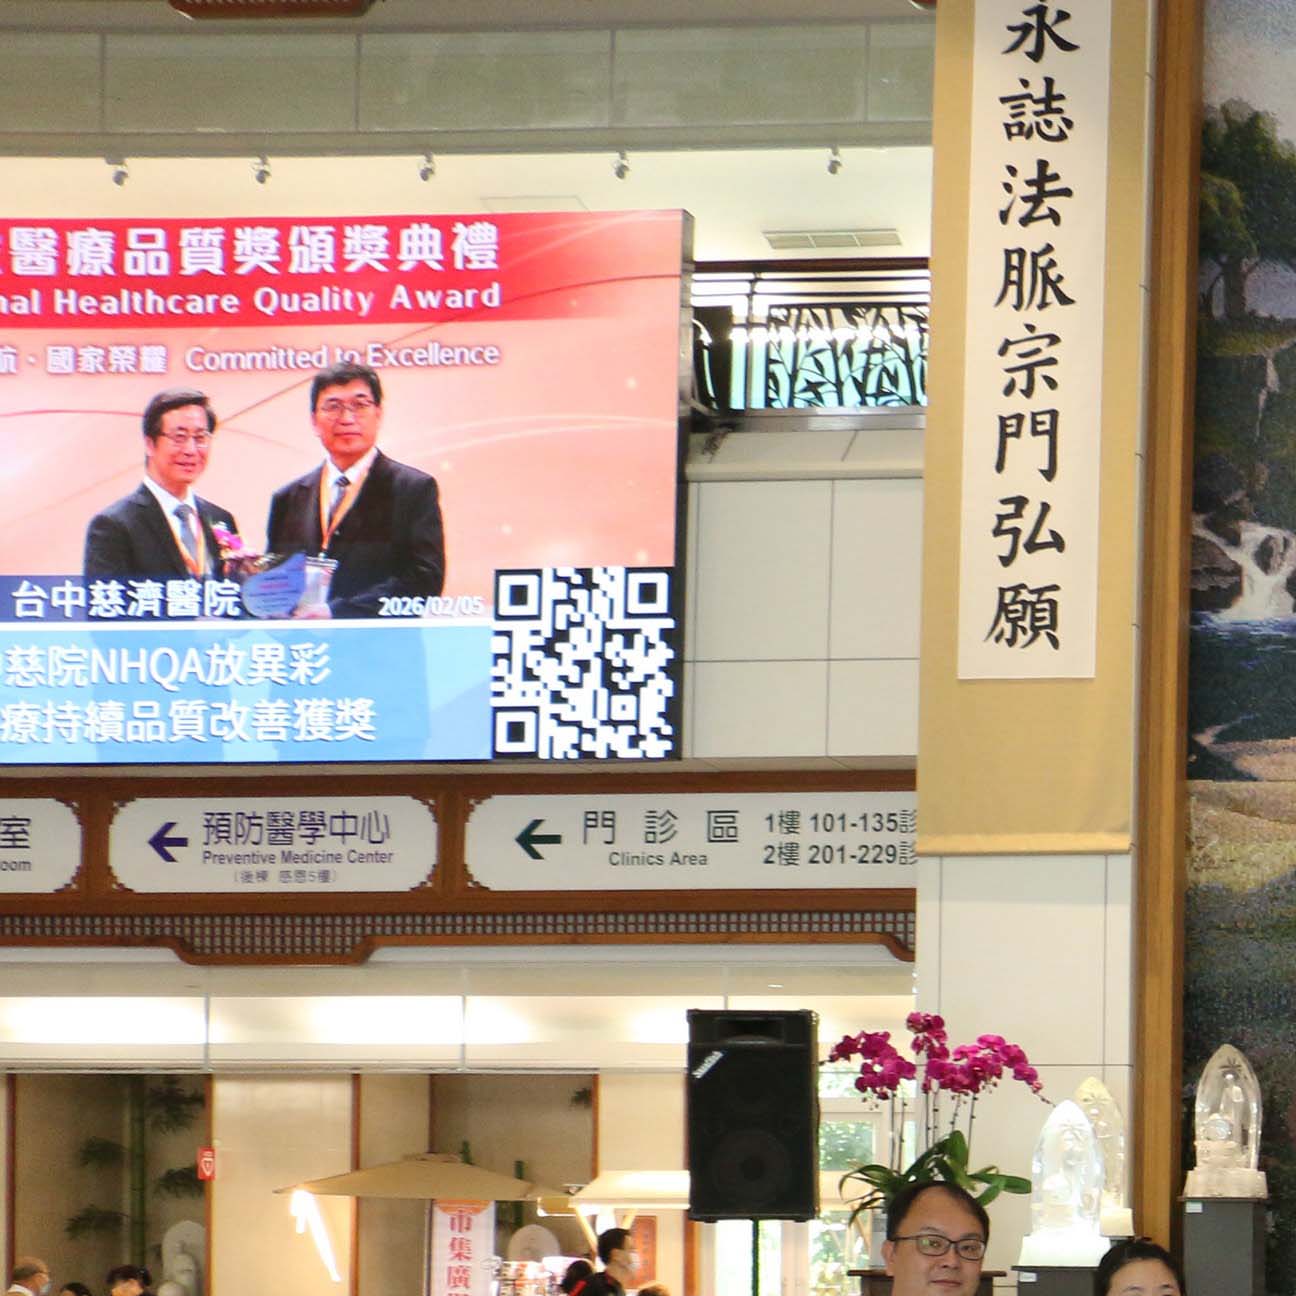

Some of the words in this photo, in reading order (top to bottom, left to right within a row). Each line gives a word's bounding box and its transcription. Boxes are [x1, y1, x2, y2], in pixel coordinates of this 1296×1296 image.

[0, 221, 500, 276] 醫療品質獎頒獎典禮
[53, 286, 241, 316] Healthcare
[253, 284, 375, 317] Quality
[389, 281, 501, 310] Award
[983, 0, 1081, 652] 永誌法脈宗門弘願
[185, 345, 329, 373] Committed
[366, 344, 500, 370] Excellence
[11, 579, 242, 619] 台中慈濟醫院
[377, 595, 484, 617] 2026/02/05
[3, 641, 331, 692] 慈院NHQA放異彩
[0, 697, 377, 744] 療持續品質改善獲獎
[0, 815, 31, 849] 室
[202, 810, 391, 847] 預防醫學中心
[583, 809, 740, 845] 門診區
[765, 810, 800, 835] 1樓
[202, 850, 277, 865] Preventive
[280, 850, 343, 864] Medicine
[347, 849, 393, 864] Center
[608, 851, 664, 867] Clinics
[670, 851, 708, 867] Area
[764, 840, 800, 866] 2樓
